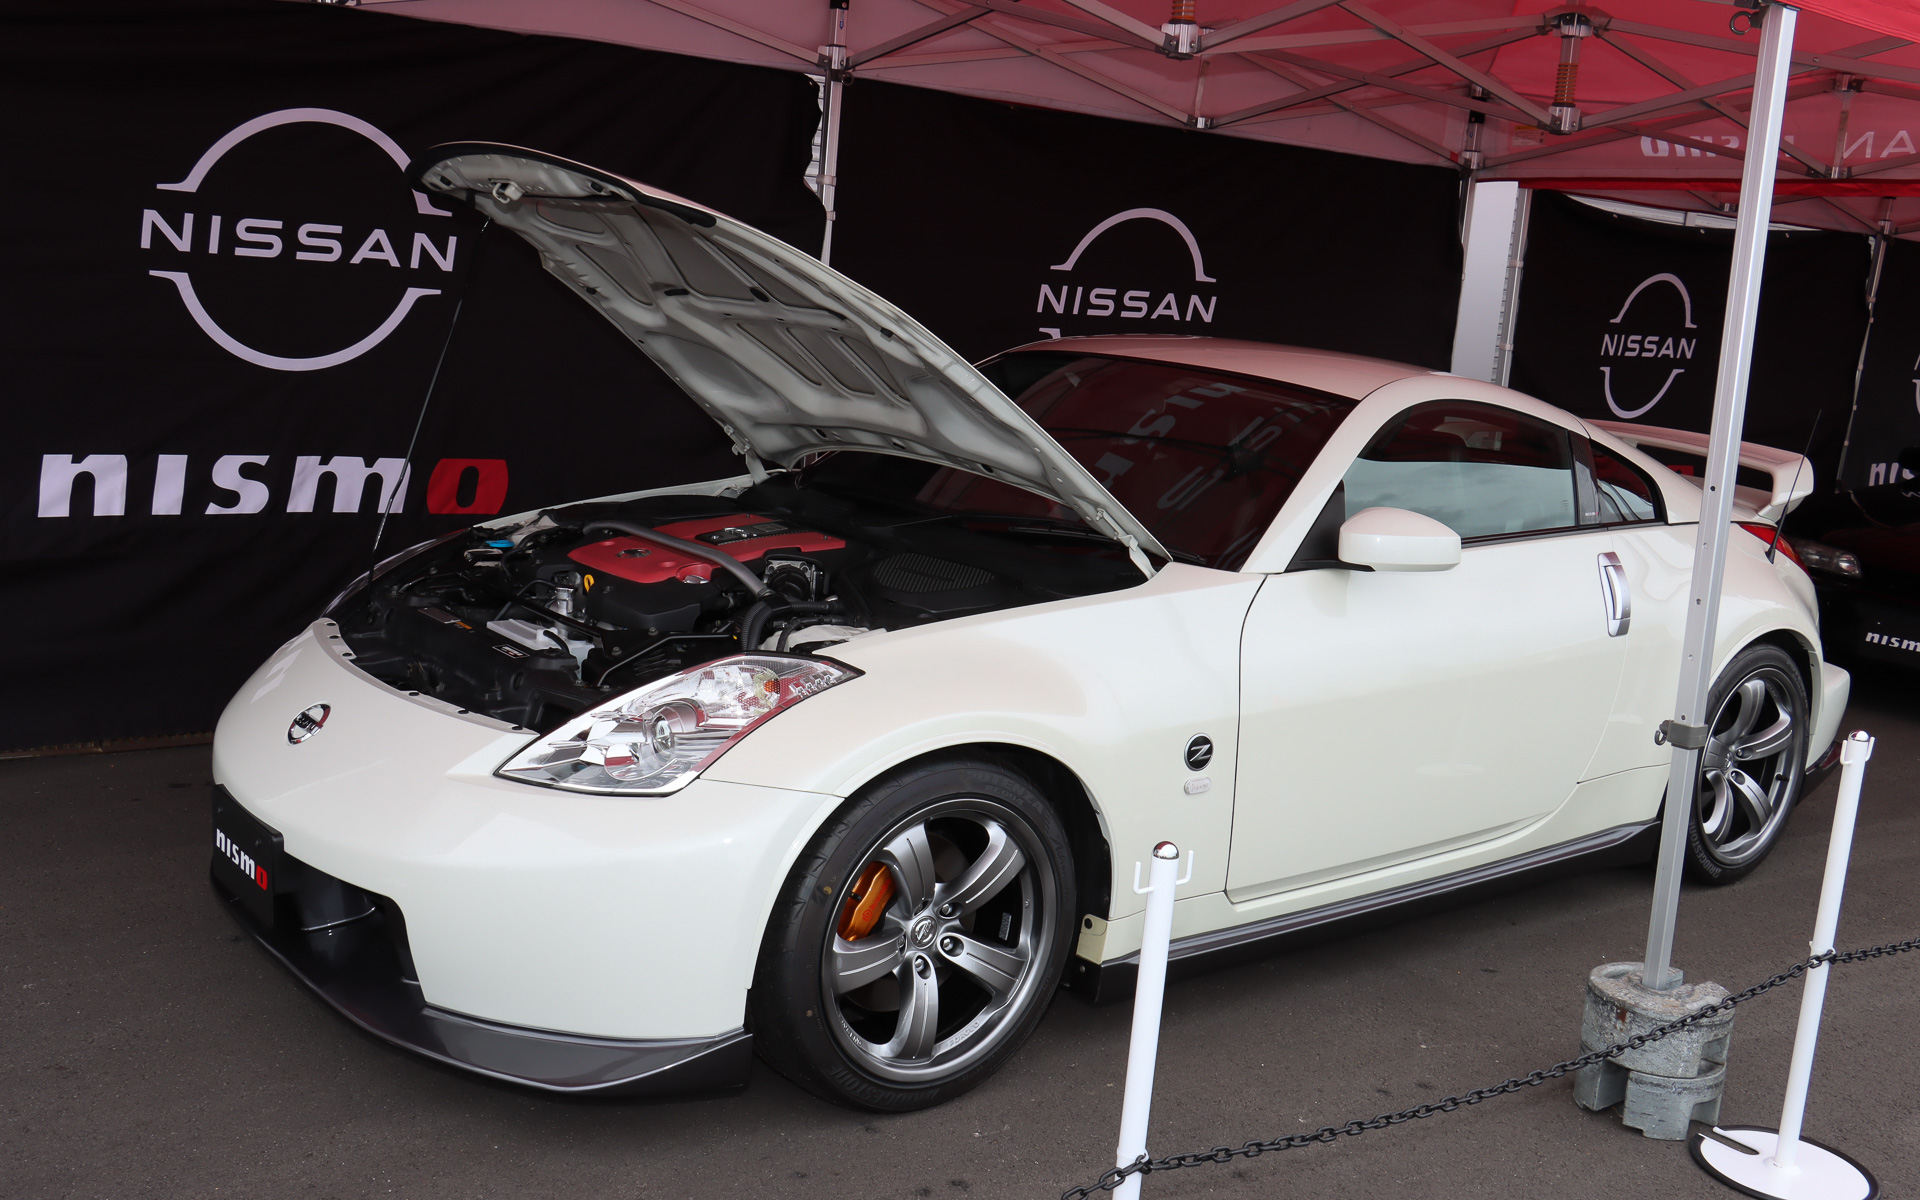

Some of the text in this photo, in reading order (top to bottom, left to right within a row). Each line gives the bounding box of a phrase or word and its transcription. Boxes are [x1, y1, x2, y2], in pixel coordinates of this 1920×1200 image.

[140, 209, 457, 272] NISSAN
[1036, 284, 1217, 322] NISSAN
[1600, 333, 1697, 359] NISSAN
[37, 453, 509, 518] nismo
[1189, 743, 1211, 762] Z
[216, 827, 268, 891] nismo
